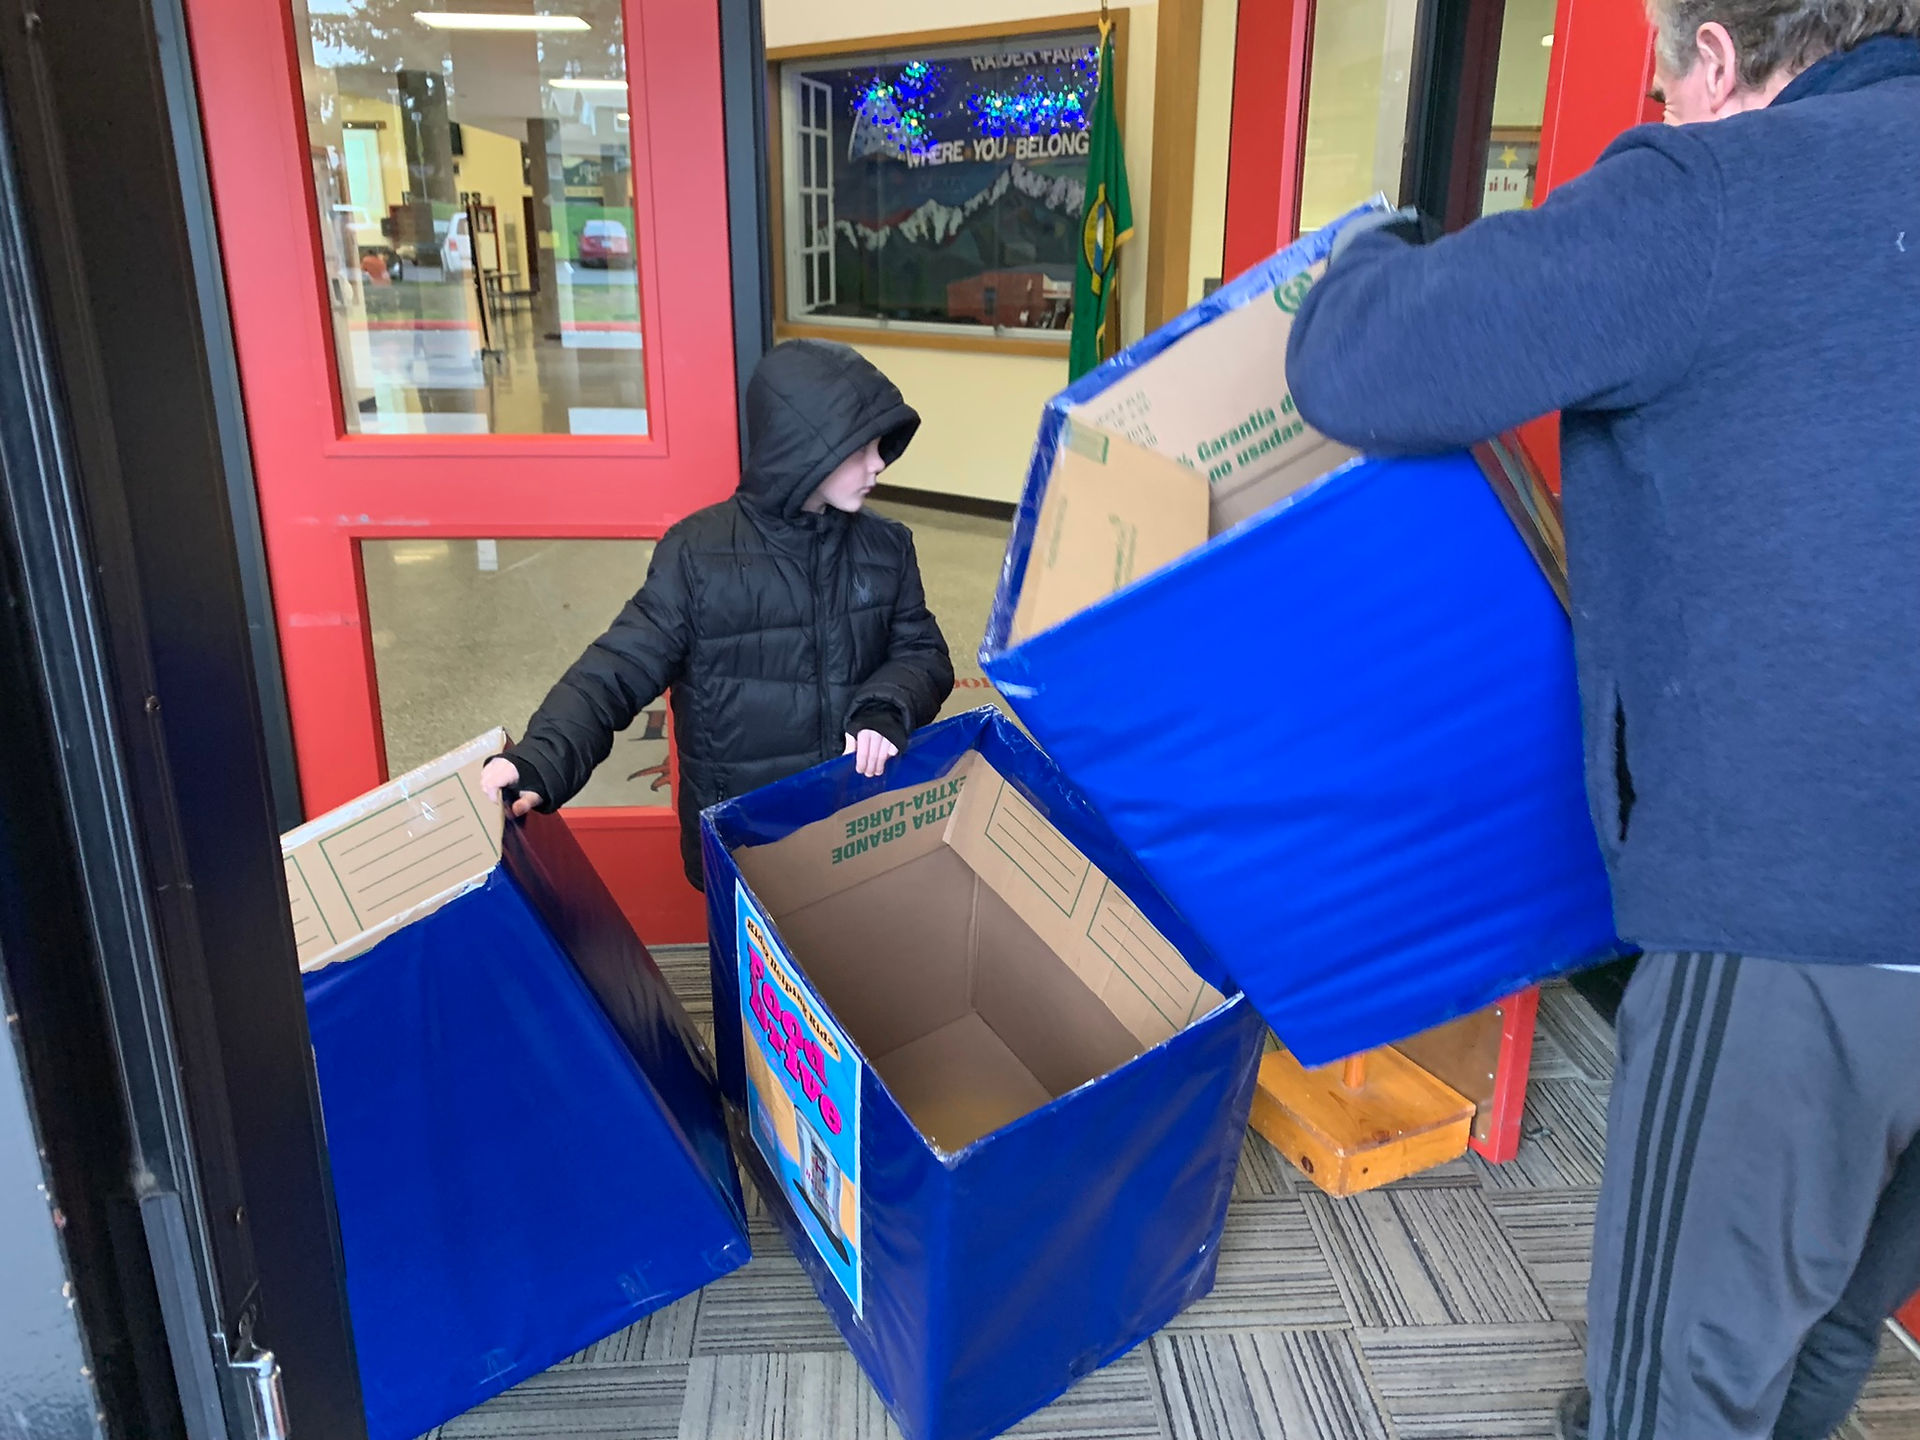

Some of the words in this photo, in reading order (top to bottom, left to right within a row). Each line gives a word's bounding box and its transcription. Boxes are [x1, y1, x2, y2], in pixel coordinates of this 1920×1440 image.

[906, 140, 965, 168] WHERE
[972, 135, 1009, 162] YOU
[1014, 131, 1090, 161] BELONG
[1208, 459, 1233, 483] no
[912, 799, 956, 830] XTRA
[831, 820, 906, 865] GRANDE
[746, 941, 829, 1089] Food
